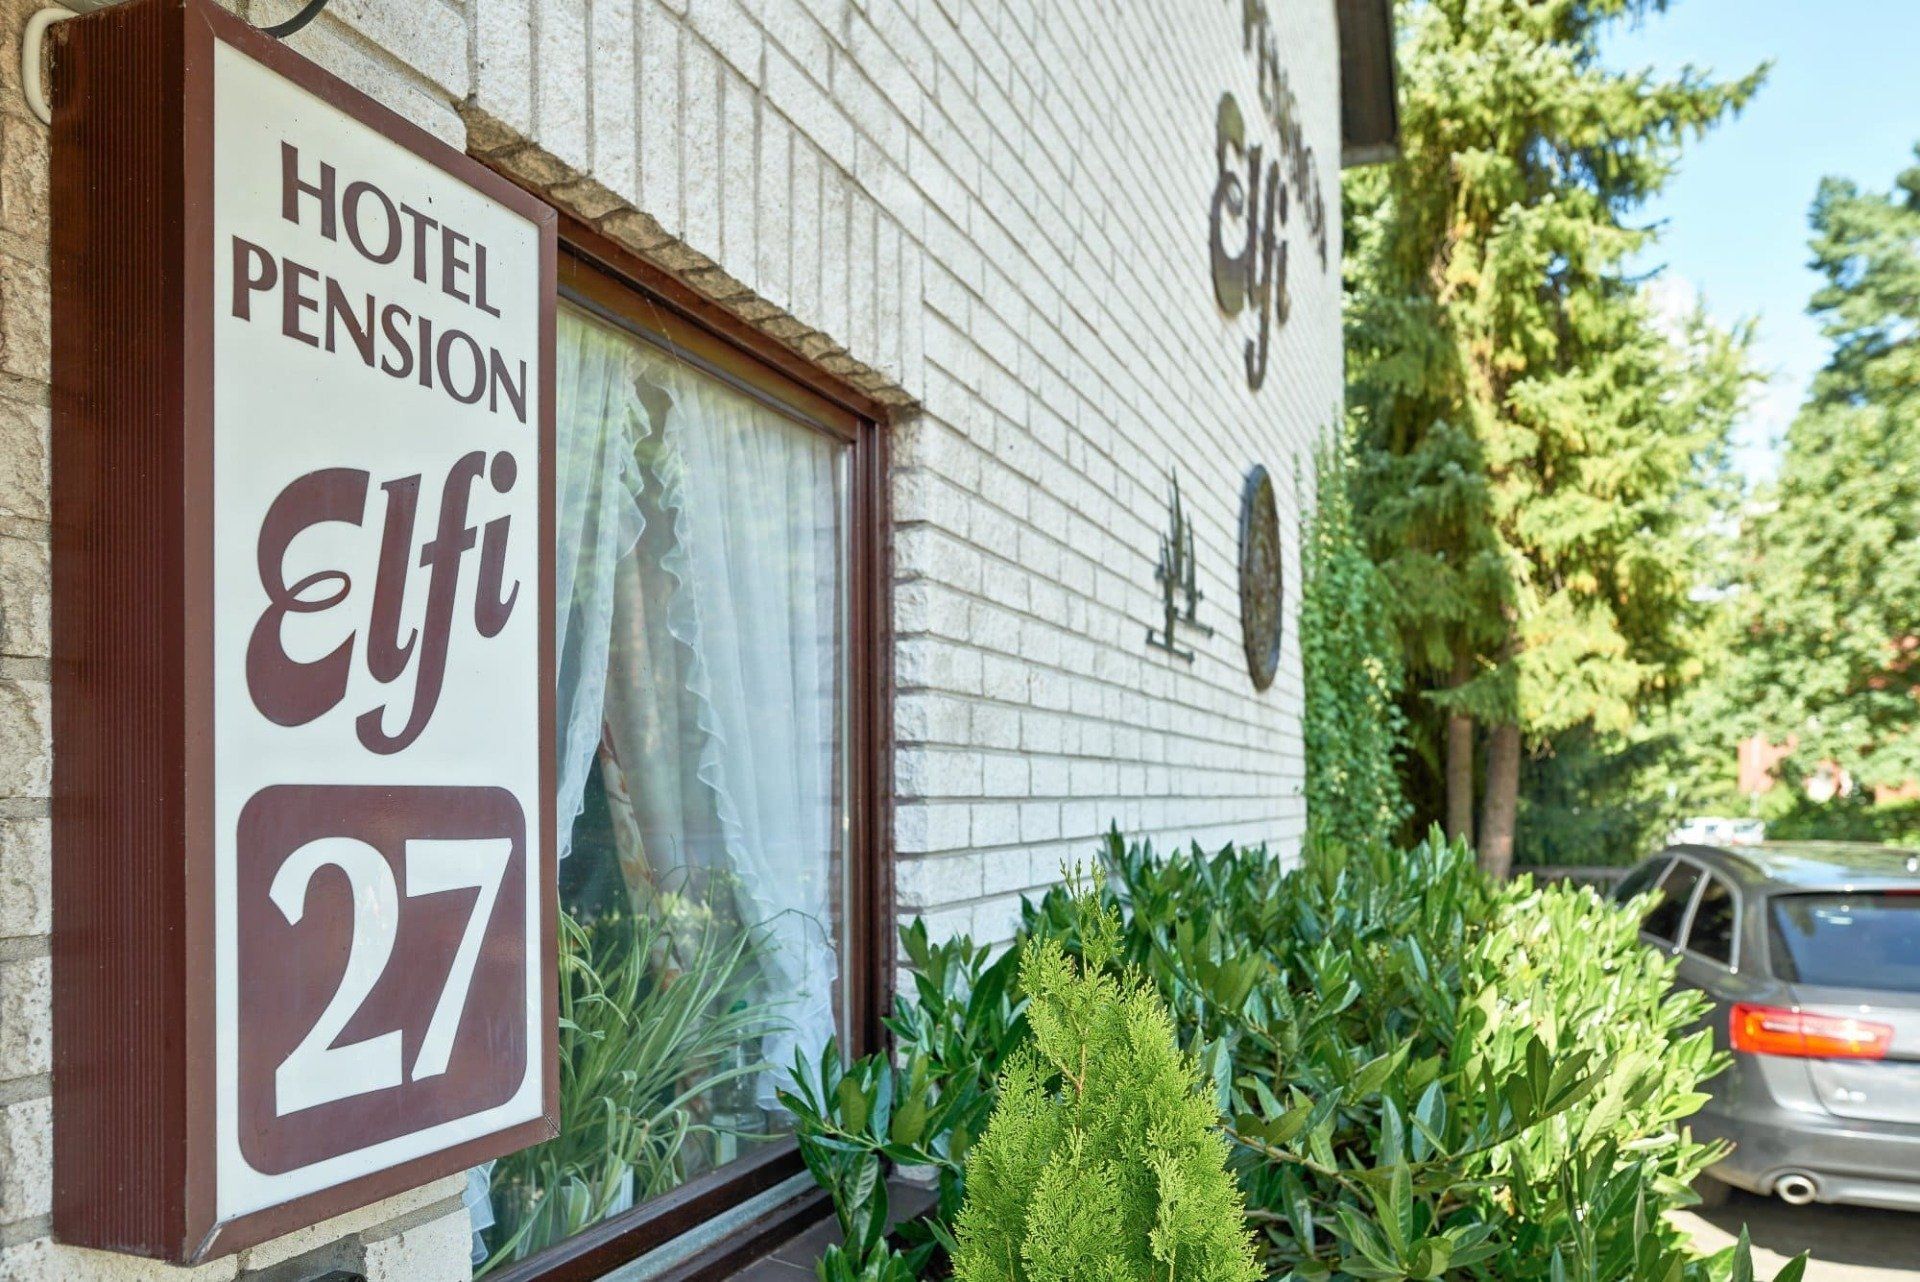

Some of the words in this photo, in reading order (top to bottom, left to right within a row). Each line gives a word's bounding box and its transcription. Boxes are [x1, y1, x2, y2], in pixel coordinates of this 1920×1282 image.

[231, 234, 527, 424] PENSION
[281, 140, 501, 319] HOTEL
[1209, 91, 1290, 391] Elfi
[246, 450, 521, 755] Elfi
[268, 836, 513, 1118] 27
